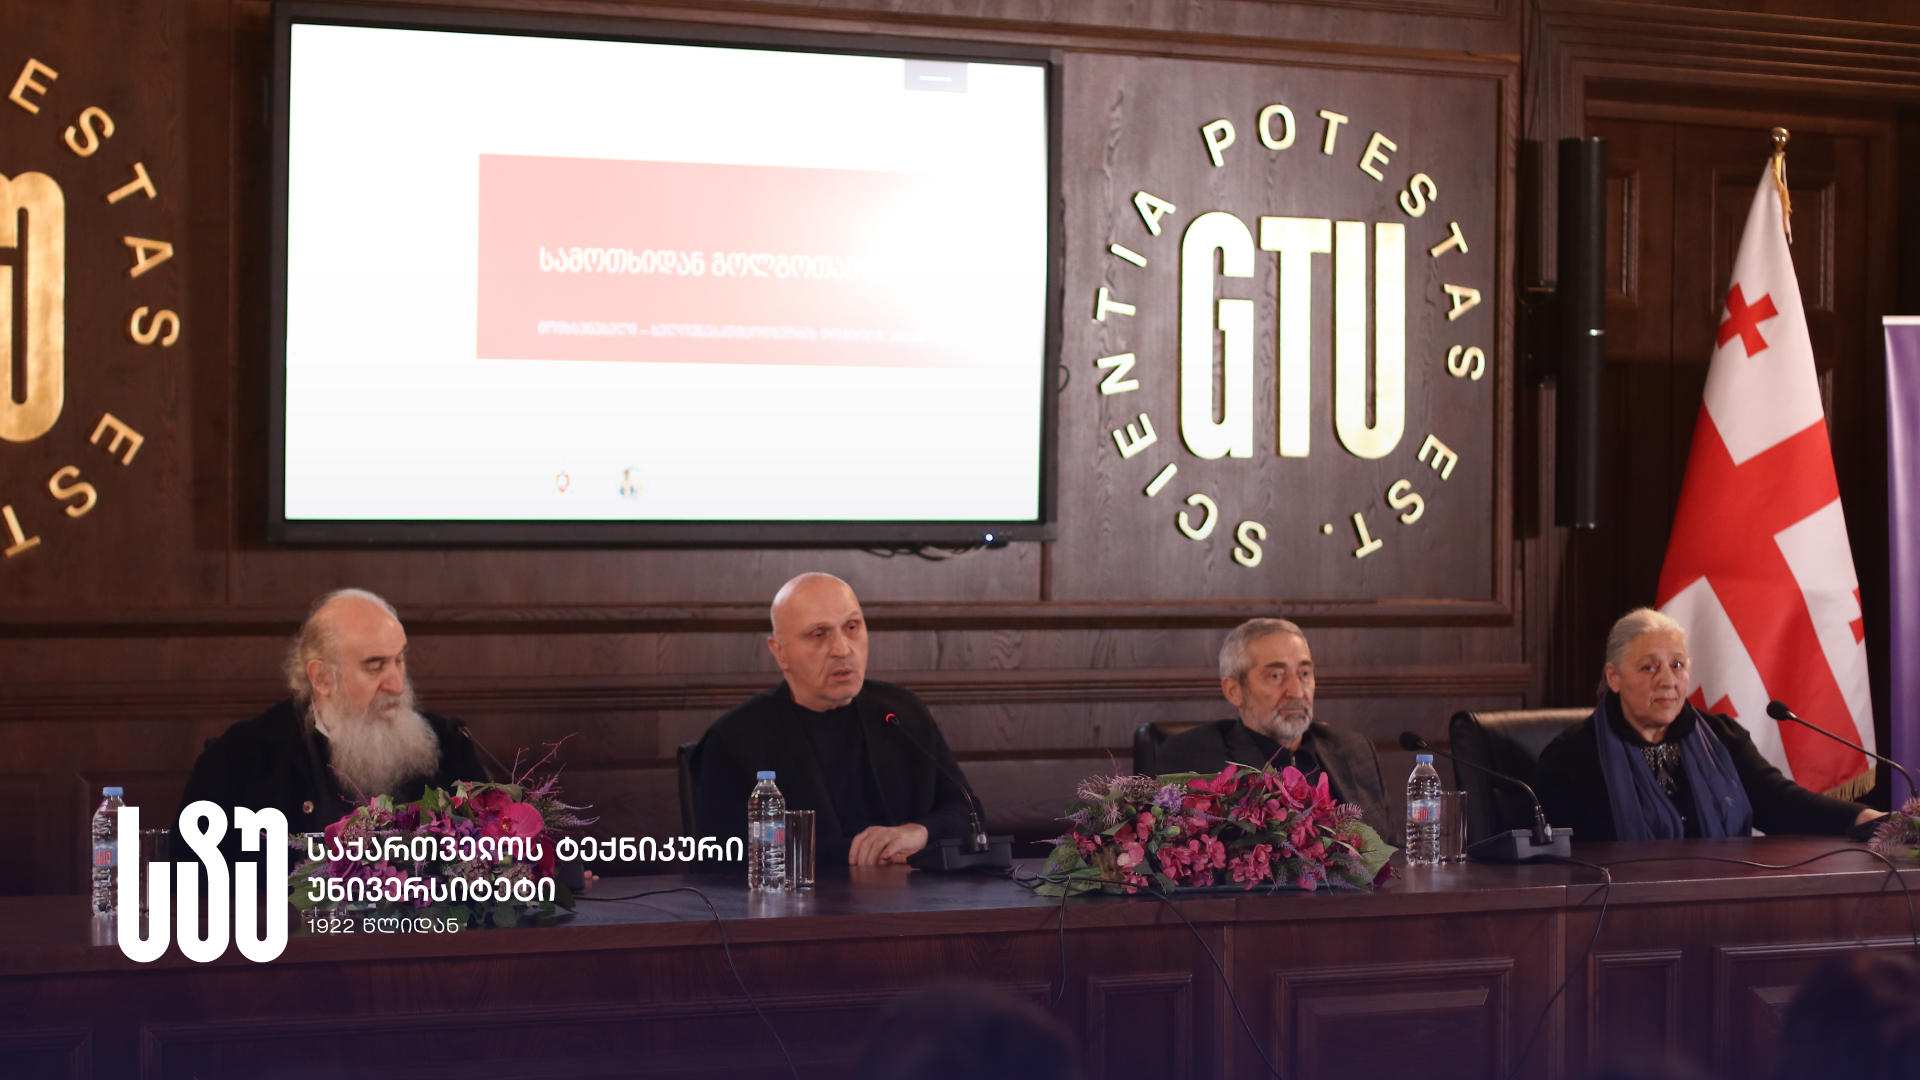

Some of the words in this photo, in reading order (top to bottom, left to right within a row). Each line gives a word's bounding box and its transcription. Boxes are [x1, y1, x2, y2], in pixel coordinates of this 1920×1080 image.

[538, 246, 706, 277] სამოთხიდან
[1095, 190, 1267, 567] SCIENTIA
[1202, 104, 1485, 381] POTESTAS
[1180, 211, 1406, 460] GTU
